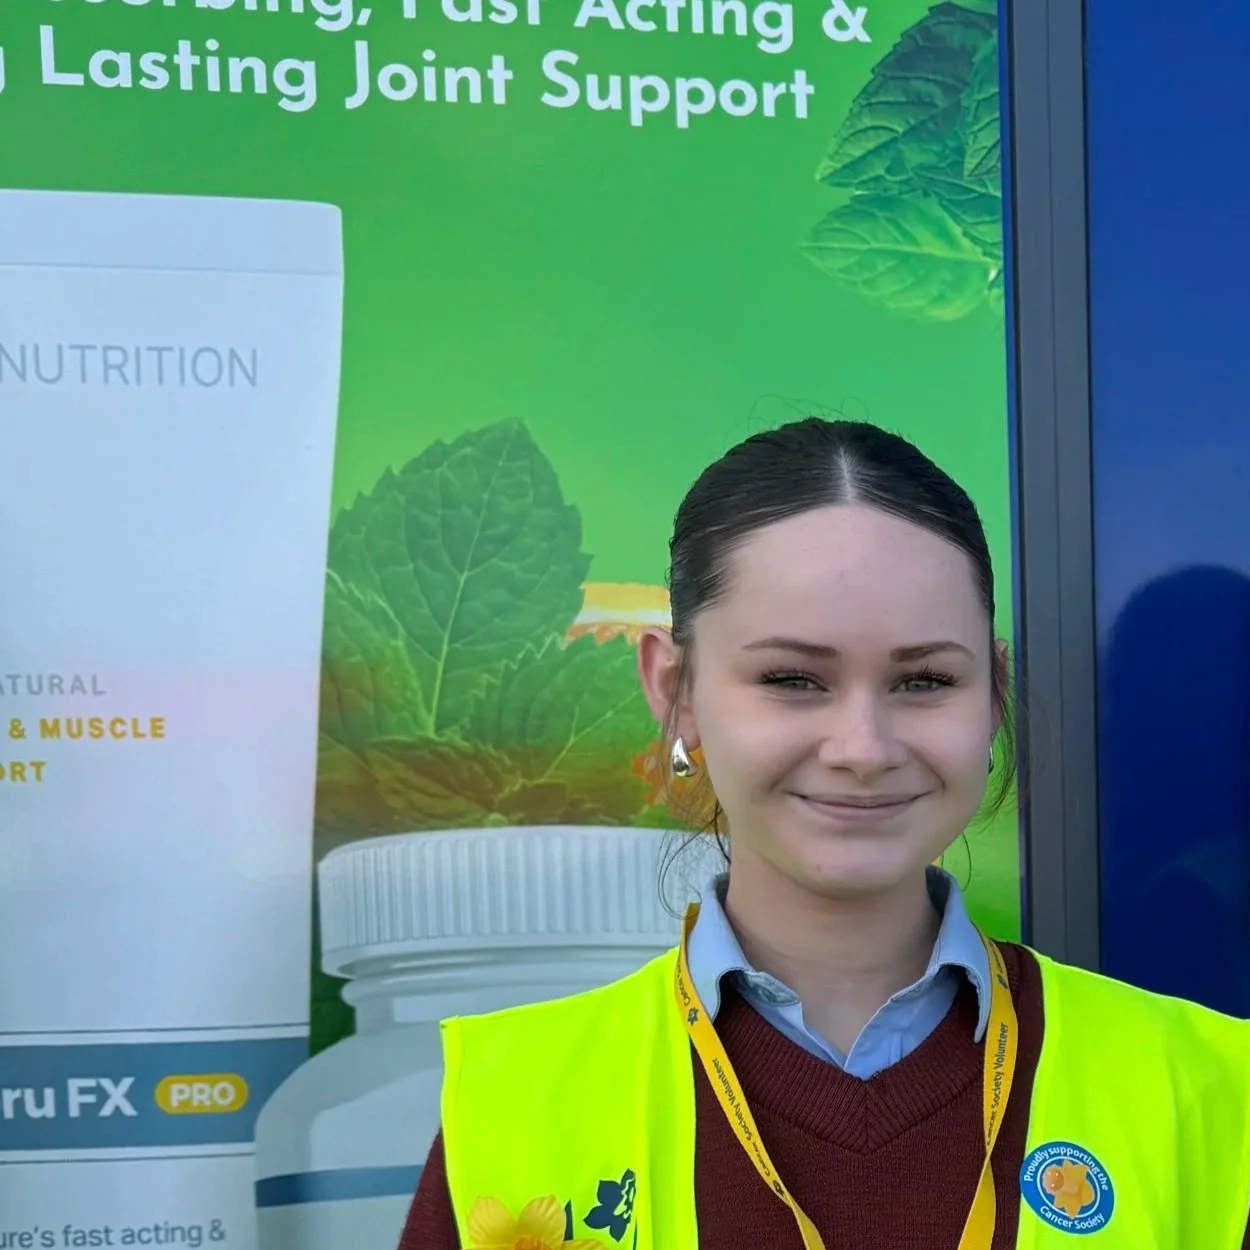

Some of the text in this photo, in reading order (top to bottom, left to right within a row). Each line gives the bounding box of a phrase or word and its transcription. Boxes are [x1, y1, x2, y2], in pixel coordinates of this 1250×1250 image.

[821, 0, 872, 42] &
[40, 25, 318, 113] Lasting
[345, 40, 513, 109] Joint
[541, 49, 815, 129] Support
[0, 343, 257, 388] NUTRITION
[9, 717, 165, 740] & MUSCLE
[993, 1022, 1009, 1068] Volunteer
[67, 1076, 138, 1118] FX
[170, 1082, 237, 1108] PRO
[712, 1057, 737, 1106] Volunteer
[992, 1069, 1005, 1111] Society
[734, 1101, 754, 1140] Society
[1024, 1146, 1109, 1191] Proudly supporting the
[63, 1224, 114, 1247] fast
[121, 1221, 203, 1248] acting
[209, 1218, 227, 1241] &
[1040, 1205, 1105, 1229] Cancer Society
